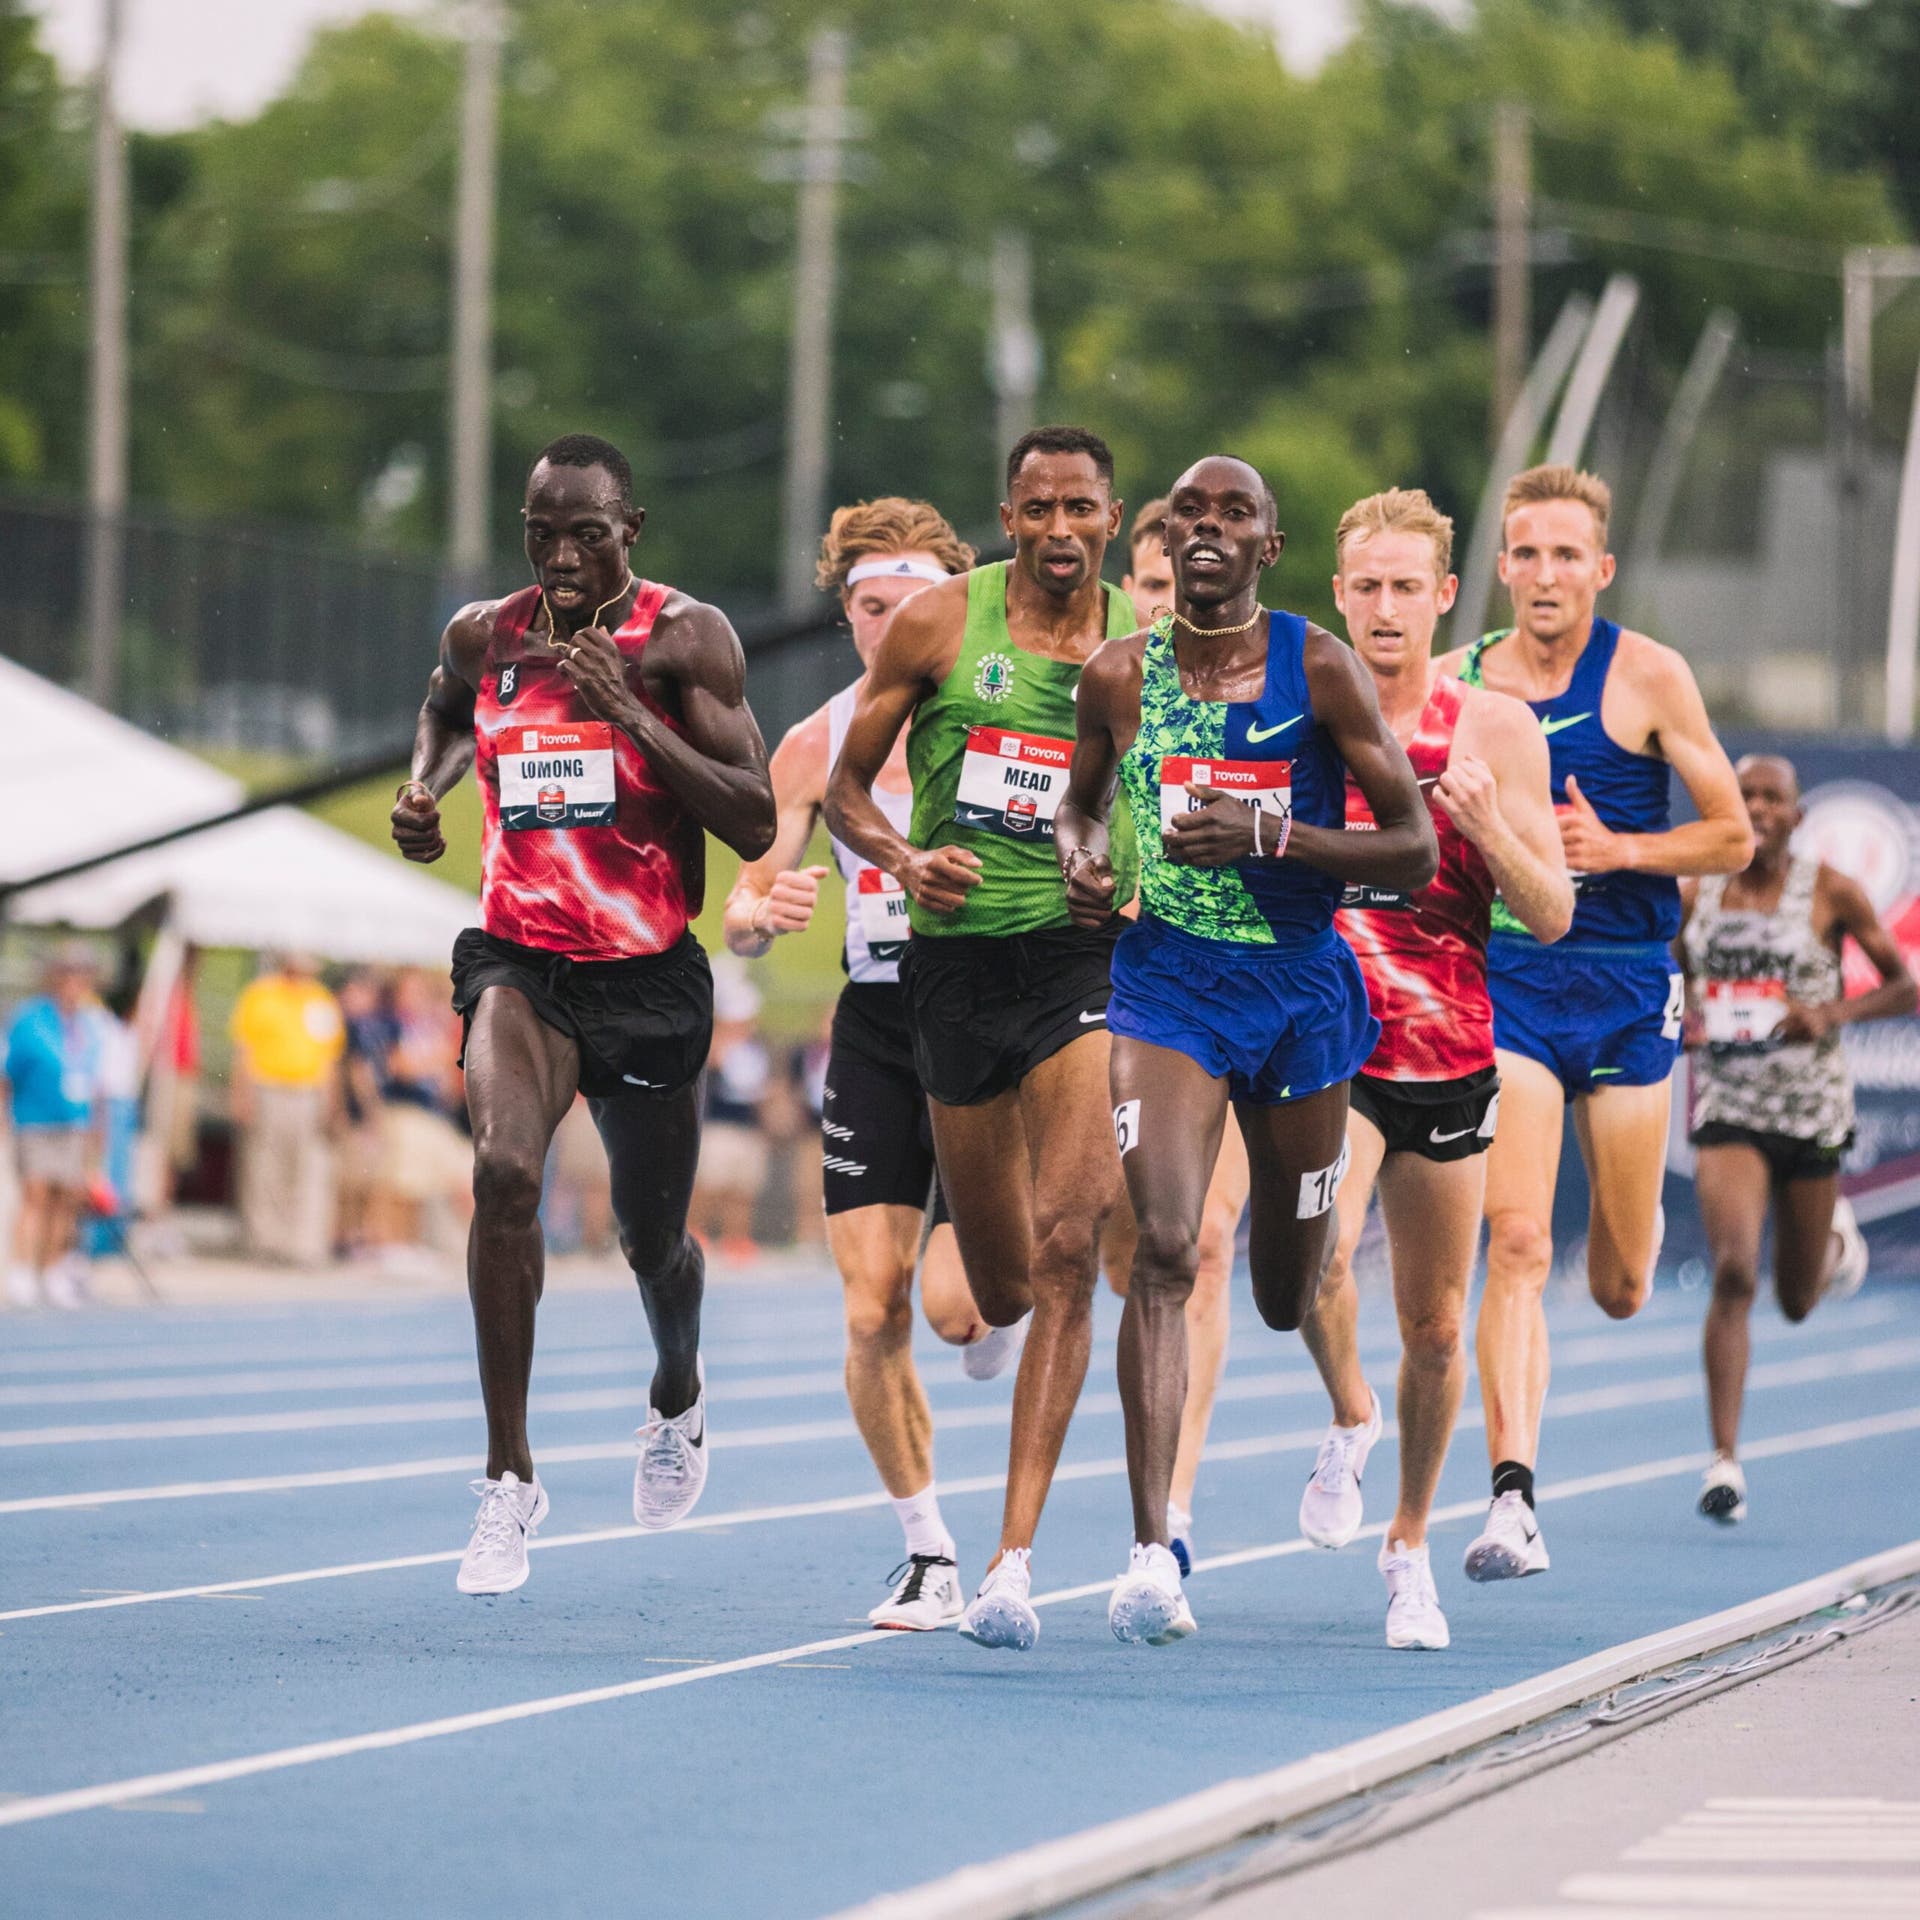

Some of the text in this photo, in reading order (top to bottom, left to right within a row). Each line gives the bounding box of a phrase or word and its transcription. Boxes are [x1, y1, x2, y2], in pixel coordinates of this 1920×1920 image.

[976, 652, 1015, 672] OREGON
[974, 674, 988, 702] TRACK
[995, 679, 1014, 702] CLUB
[540, 734, 581, 746] TOYOTA
[1023, 745, 1066, 762] TOYOTA
[521, 758, 584, 780] LOMONG
[1003, 766, 1052, 793] MEAD
[1213, 770, 1258, 784] TOYOTA
